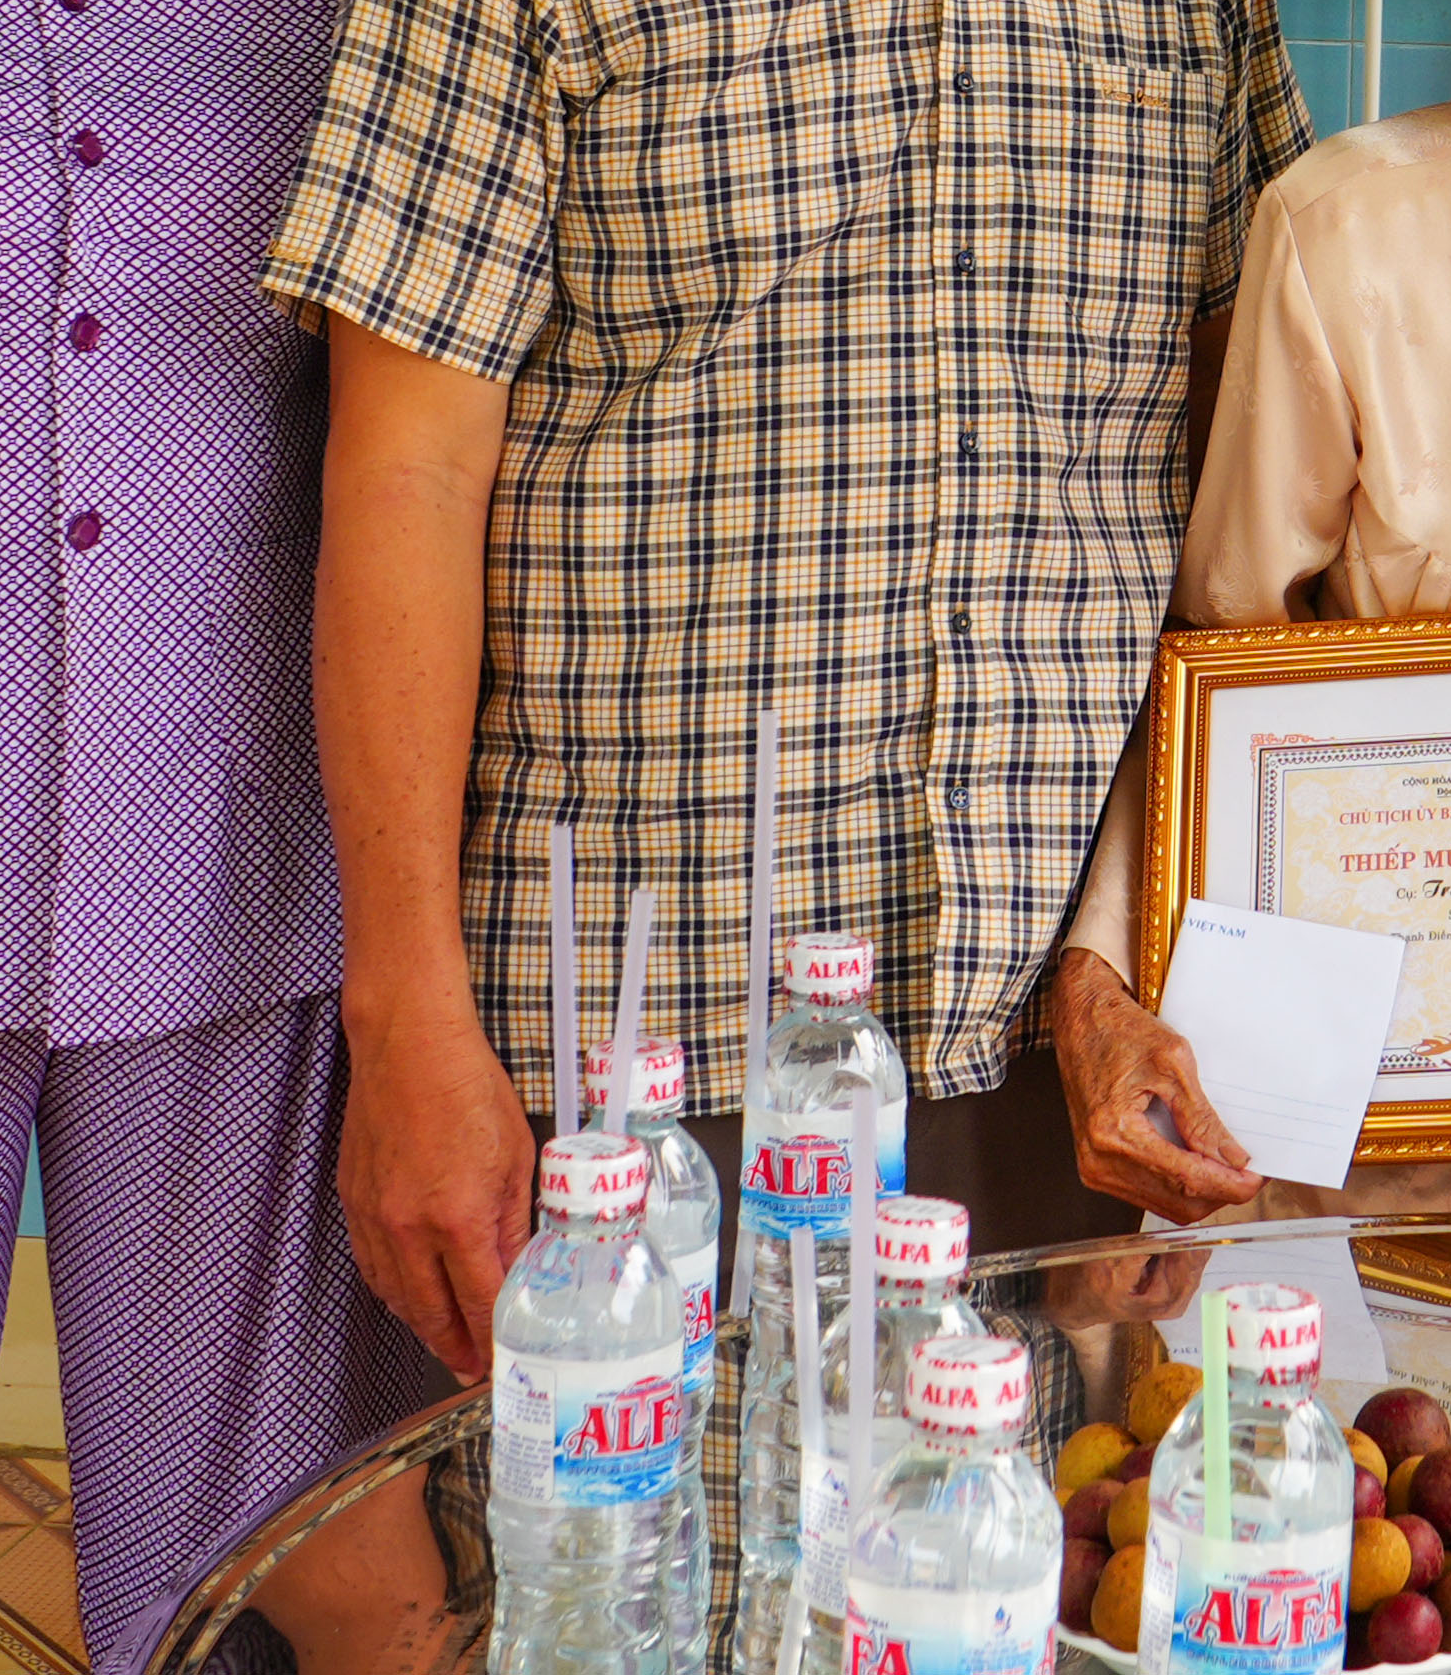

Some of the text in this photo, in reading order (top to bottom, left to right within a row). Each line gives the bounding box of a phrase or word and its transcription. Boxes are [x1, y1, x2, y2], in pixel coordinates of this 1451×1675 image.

[1402, 777, 1429, 787] CỘNG
[1339, 807, 1371, 825] CHỦ
[1375, 808, 1412, 825] TỊCH
[1417, 805, 1437, 821] ỦY
[1340, 843, 1416, 873] THIẾP
[1396, 887, 1418, 902] Cụ:
[1188, 918, 1216, 932] VIỆT
[1219, 924, 1246, 939] NAM
[805, 958, 862, 980] ALFA
[591, 1163, 647, 1195] ALFA
[1259, 1320, 1317, 1350] ALFA
[921, 1382, 979, 1409] ALFA
[1185, 1579, 1344, 1648] ALFA
